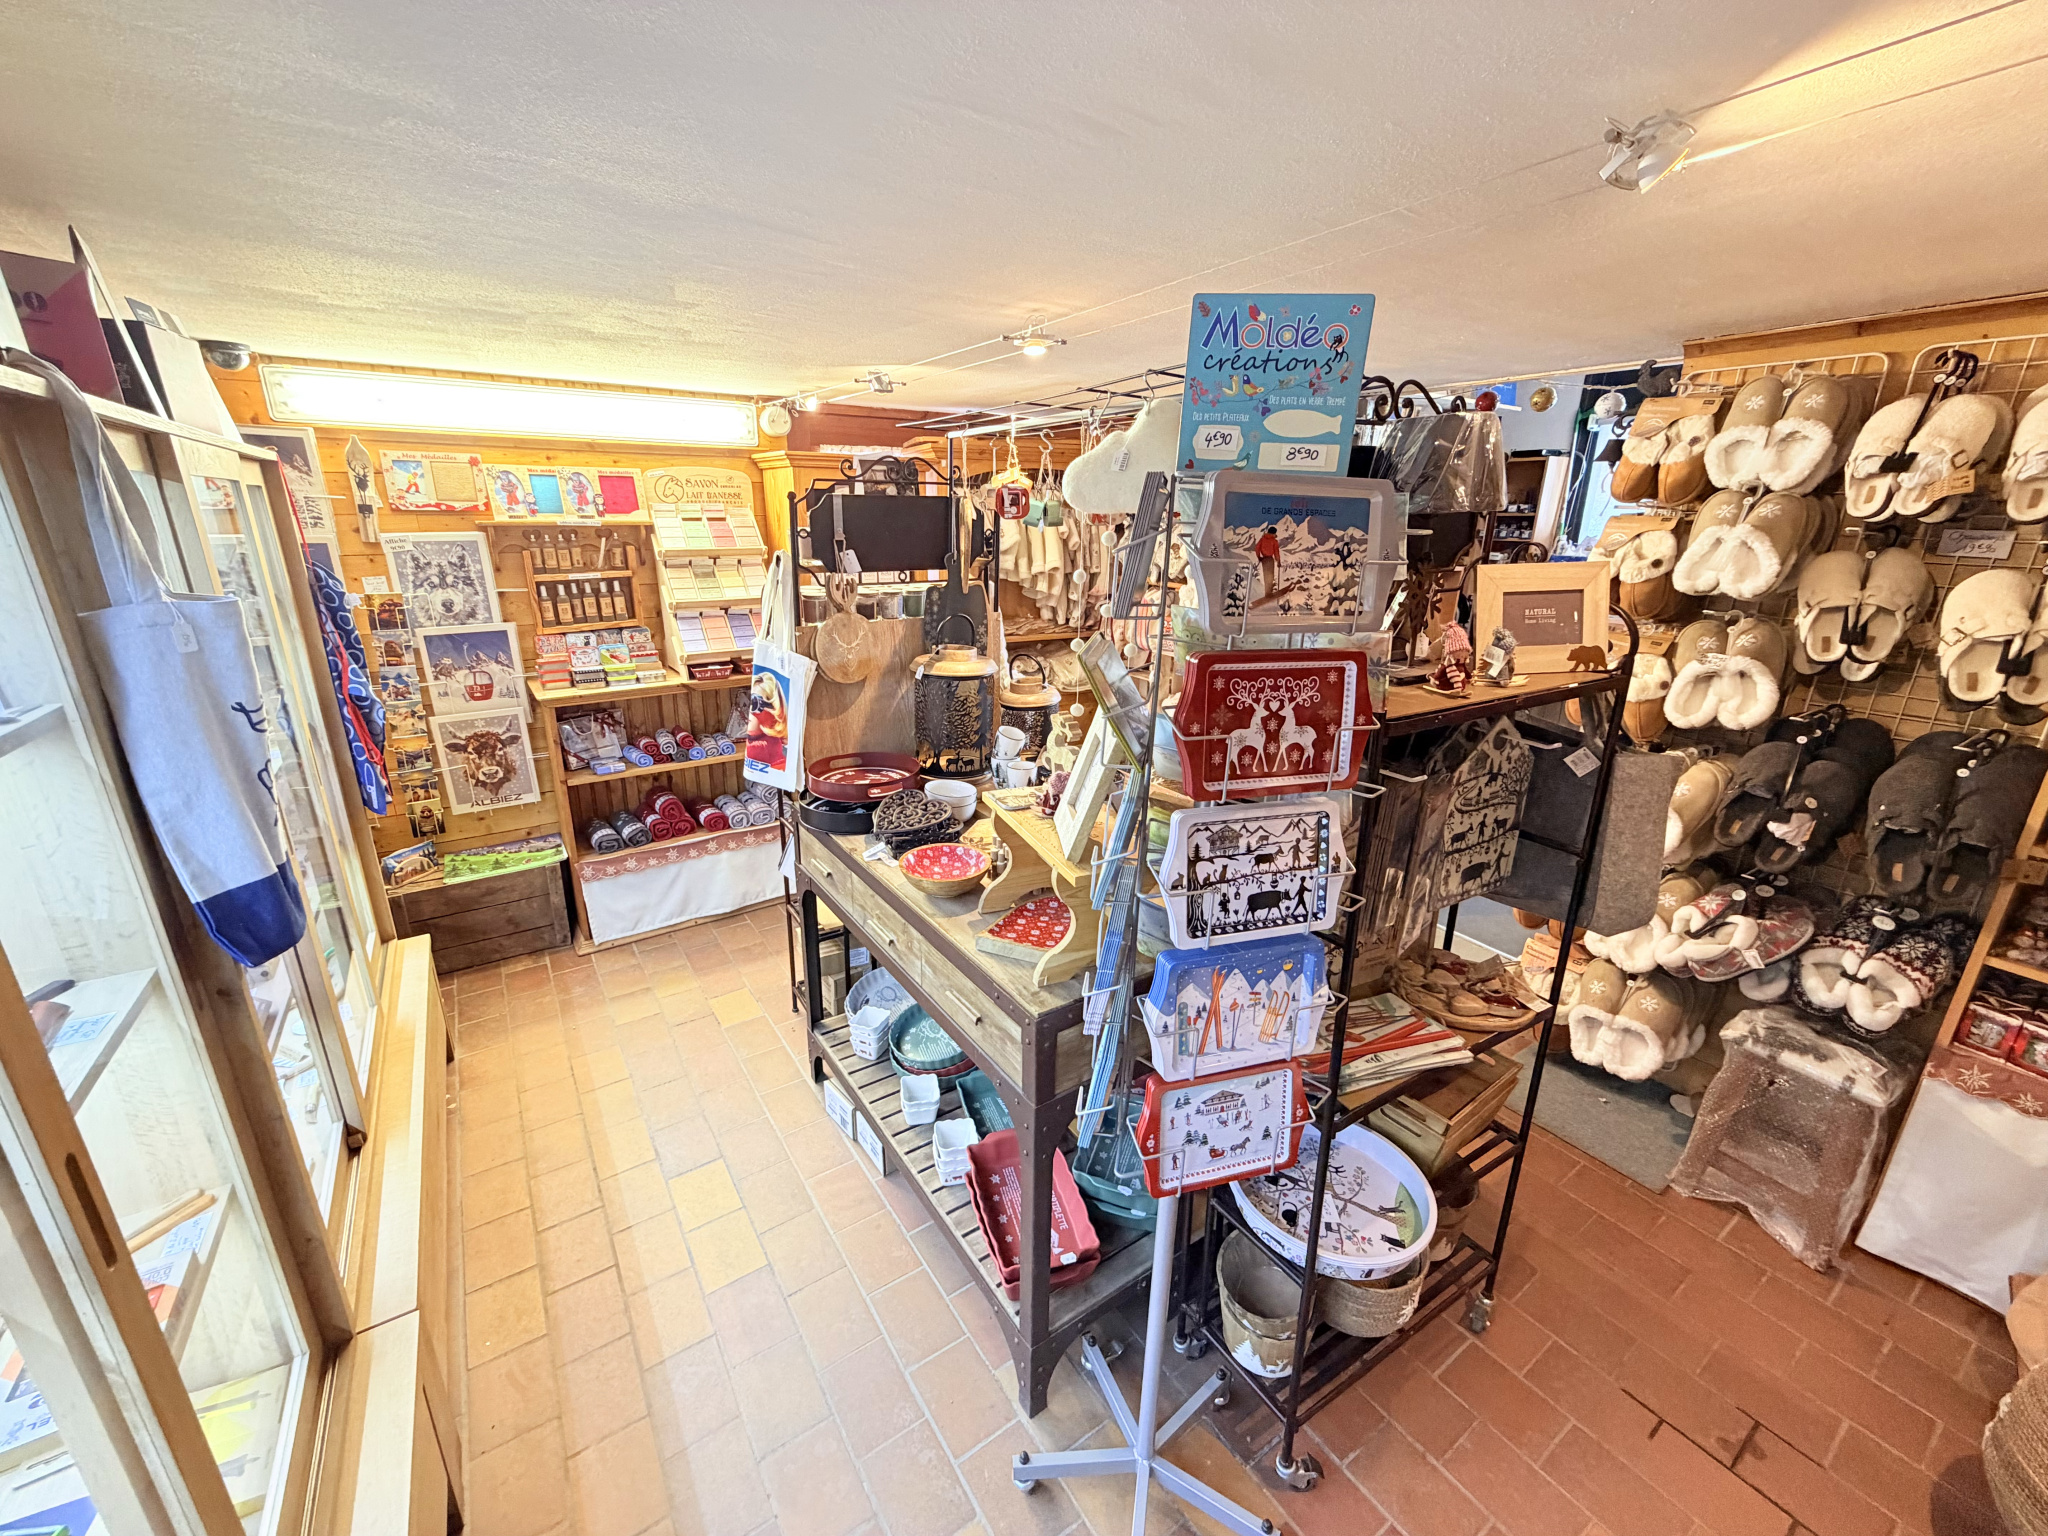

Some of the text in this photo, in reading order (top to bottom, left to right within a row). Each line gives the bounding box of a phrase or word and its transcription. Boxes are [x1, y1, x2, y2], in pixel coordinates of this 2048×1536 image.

[1203, 348, 1333, 375] créations
[1298, 397, 1307, 405] EN
[1204, 431, 1233, 448] 4€90
[1285, 447, 1319, 461] 8€90
[685, 477, 719, 488] SAVON
[685, 491, 703, 499] LAIT
[1261, 507, 1272, 515] DE
[1273, 507, 1303, 516] GRANDS
[1524, 608, 1556, 616] NATURAL
[470, 793, 524, 808] ALBIEZ
